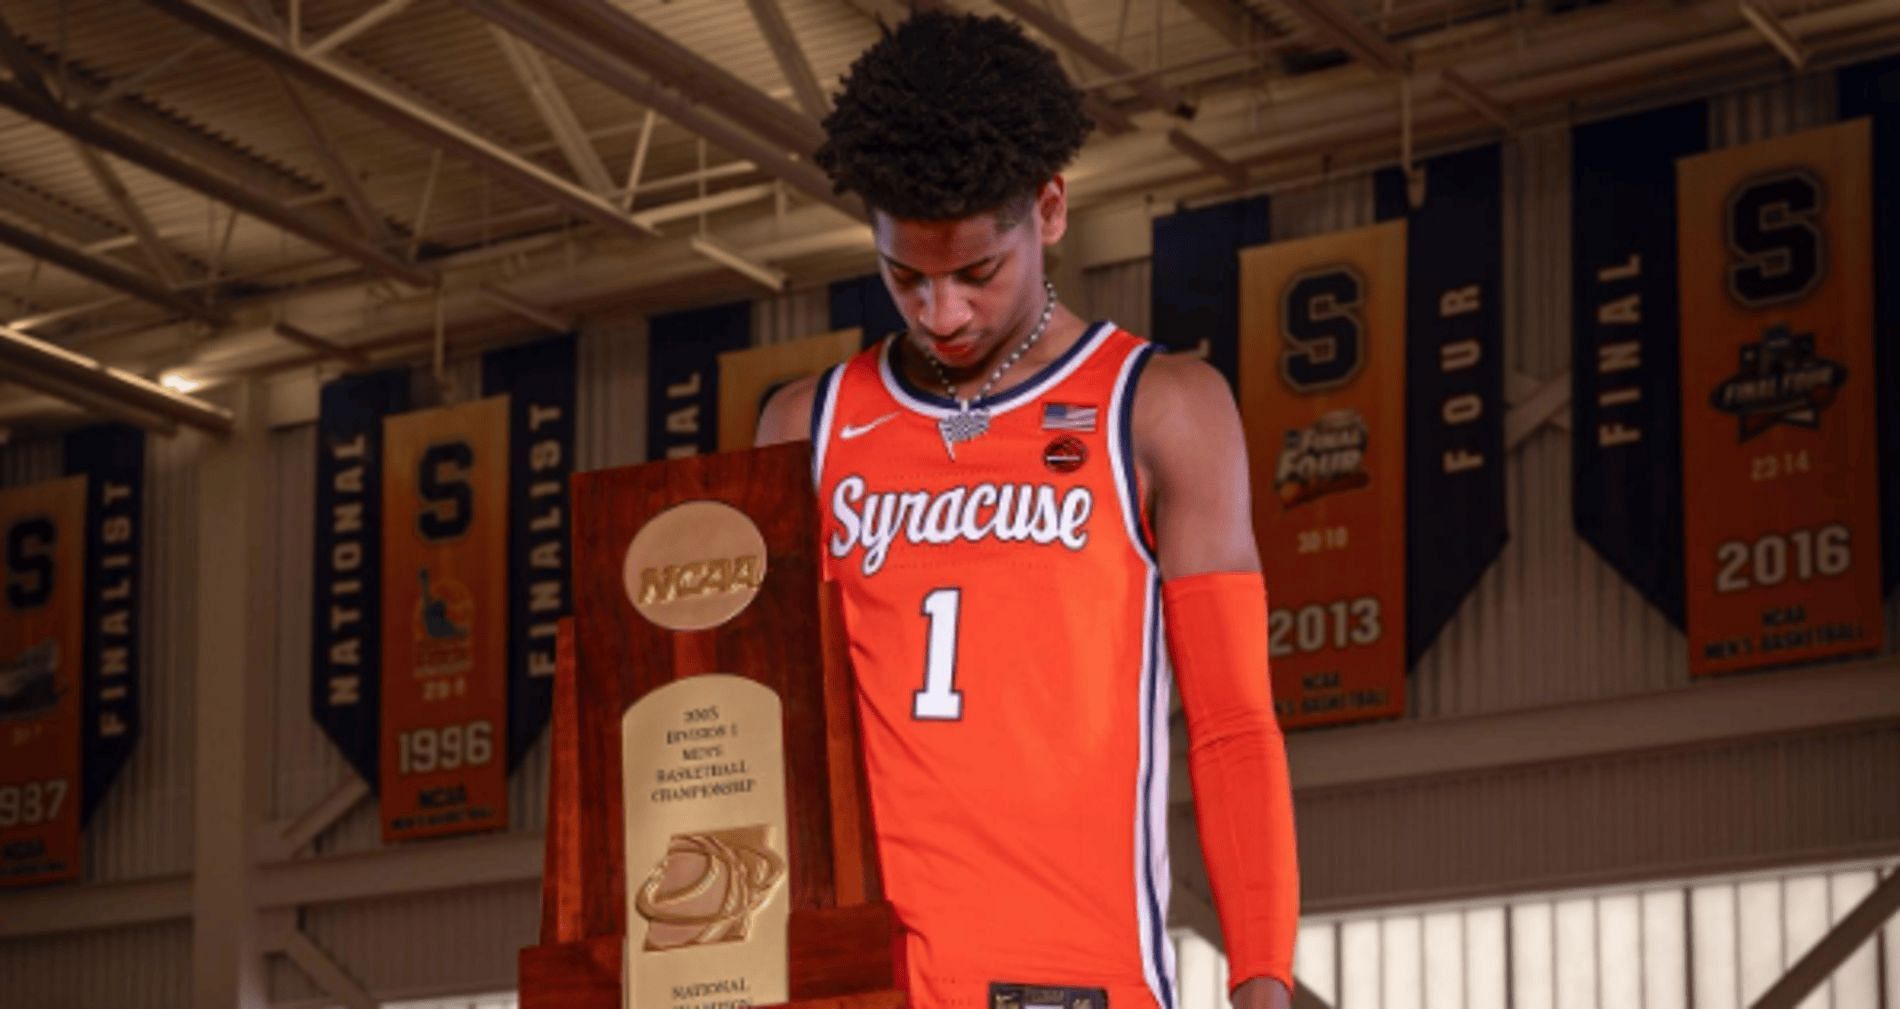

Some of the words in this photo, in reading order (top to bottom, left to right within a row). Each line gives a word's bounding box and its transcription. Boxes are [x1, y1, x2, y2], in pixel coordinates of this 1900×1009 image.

[1442, 284, 1484, 473] FOUR
[1599, 253, 1642, 447] FINAL
[528, 404, 563, 677] FINALIST
[830, 475, 1093, 576] Syracuse
[1715, 524, 1852, 593] 2016
[329, 434, 367, 706] NATIONAL
[636, 553, 761, 607] NCAA
[100, 482, 133, 737] FINALIST
[1268, 597, 1382, 657] 2013
[911, 586, 965, 722] 1
[397, 719, 494, 777] 1996
[666, 726, 726, 744] DIVISION
[650, 778, 756, 803] CHAMPIONSHIP
[656, 760, 746, 783] BASKETBALL
[671, 976, 750, 1000] NATIONAL
